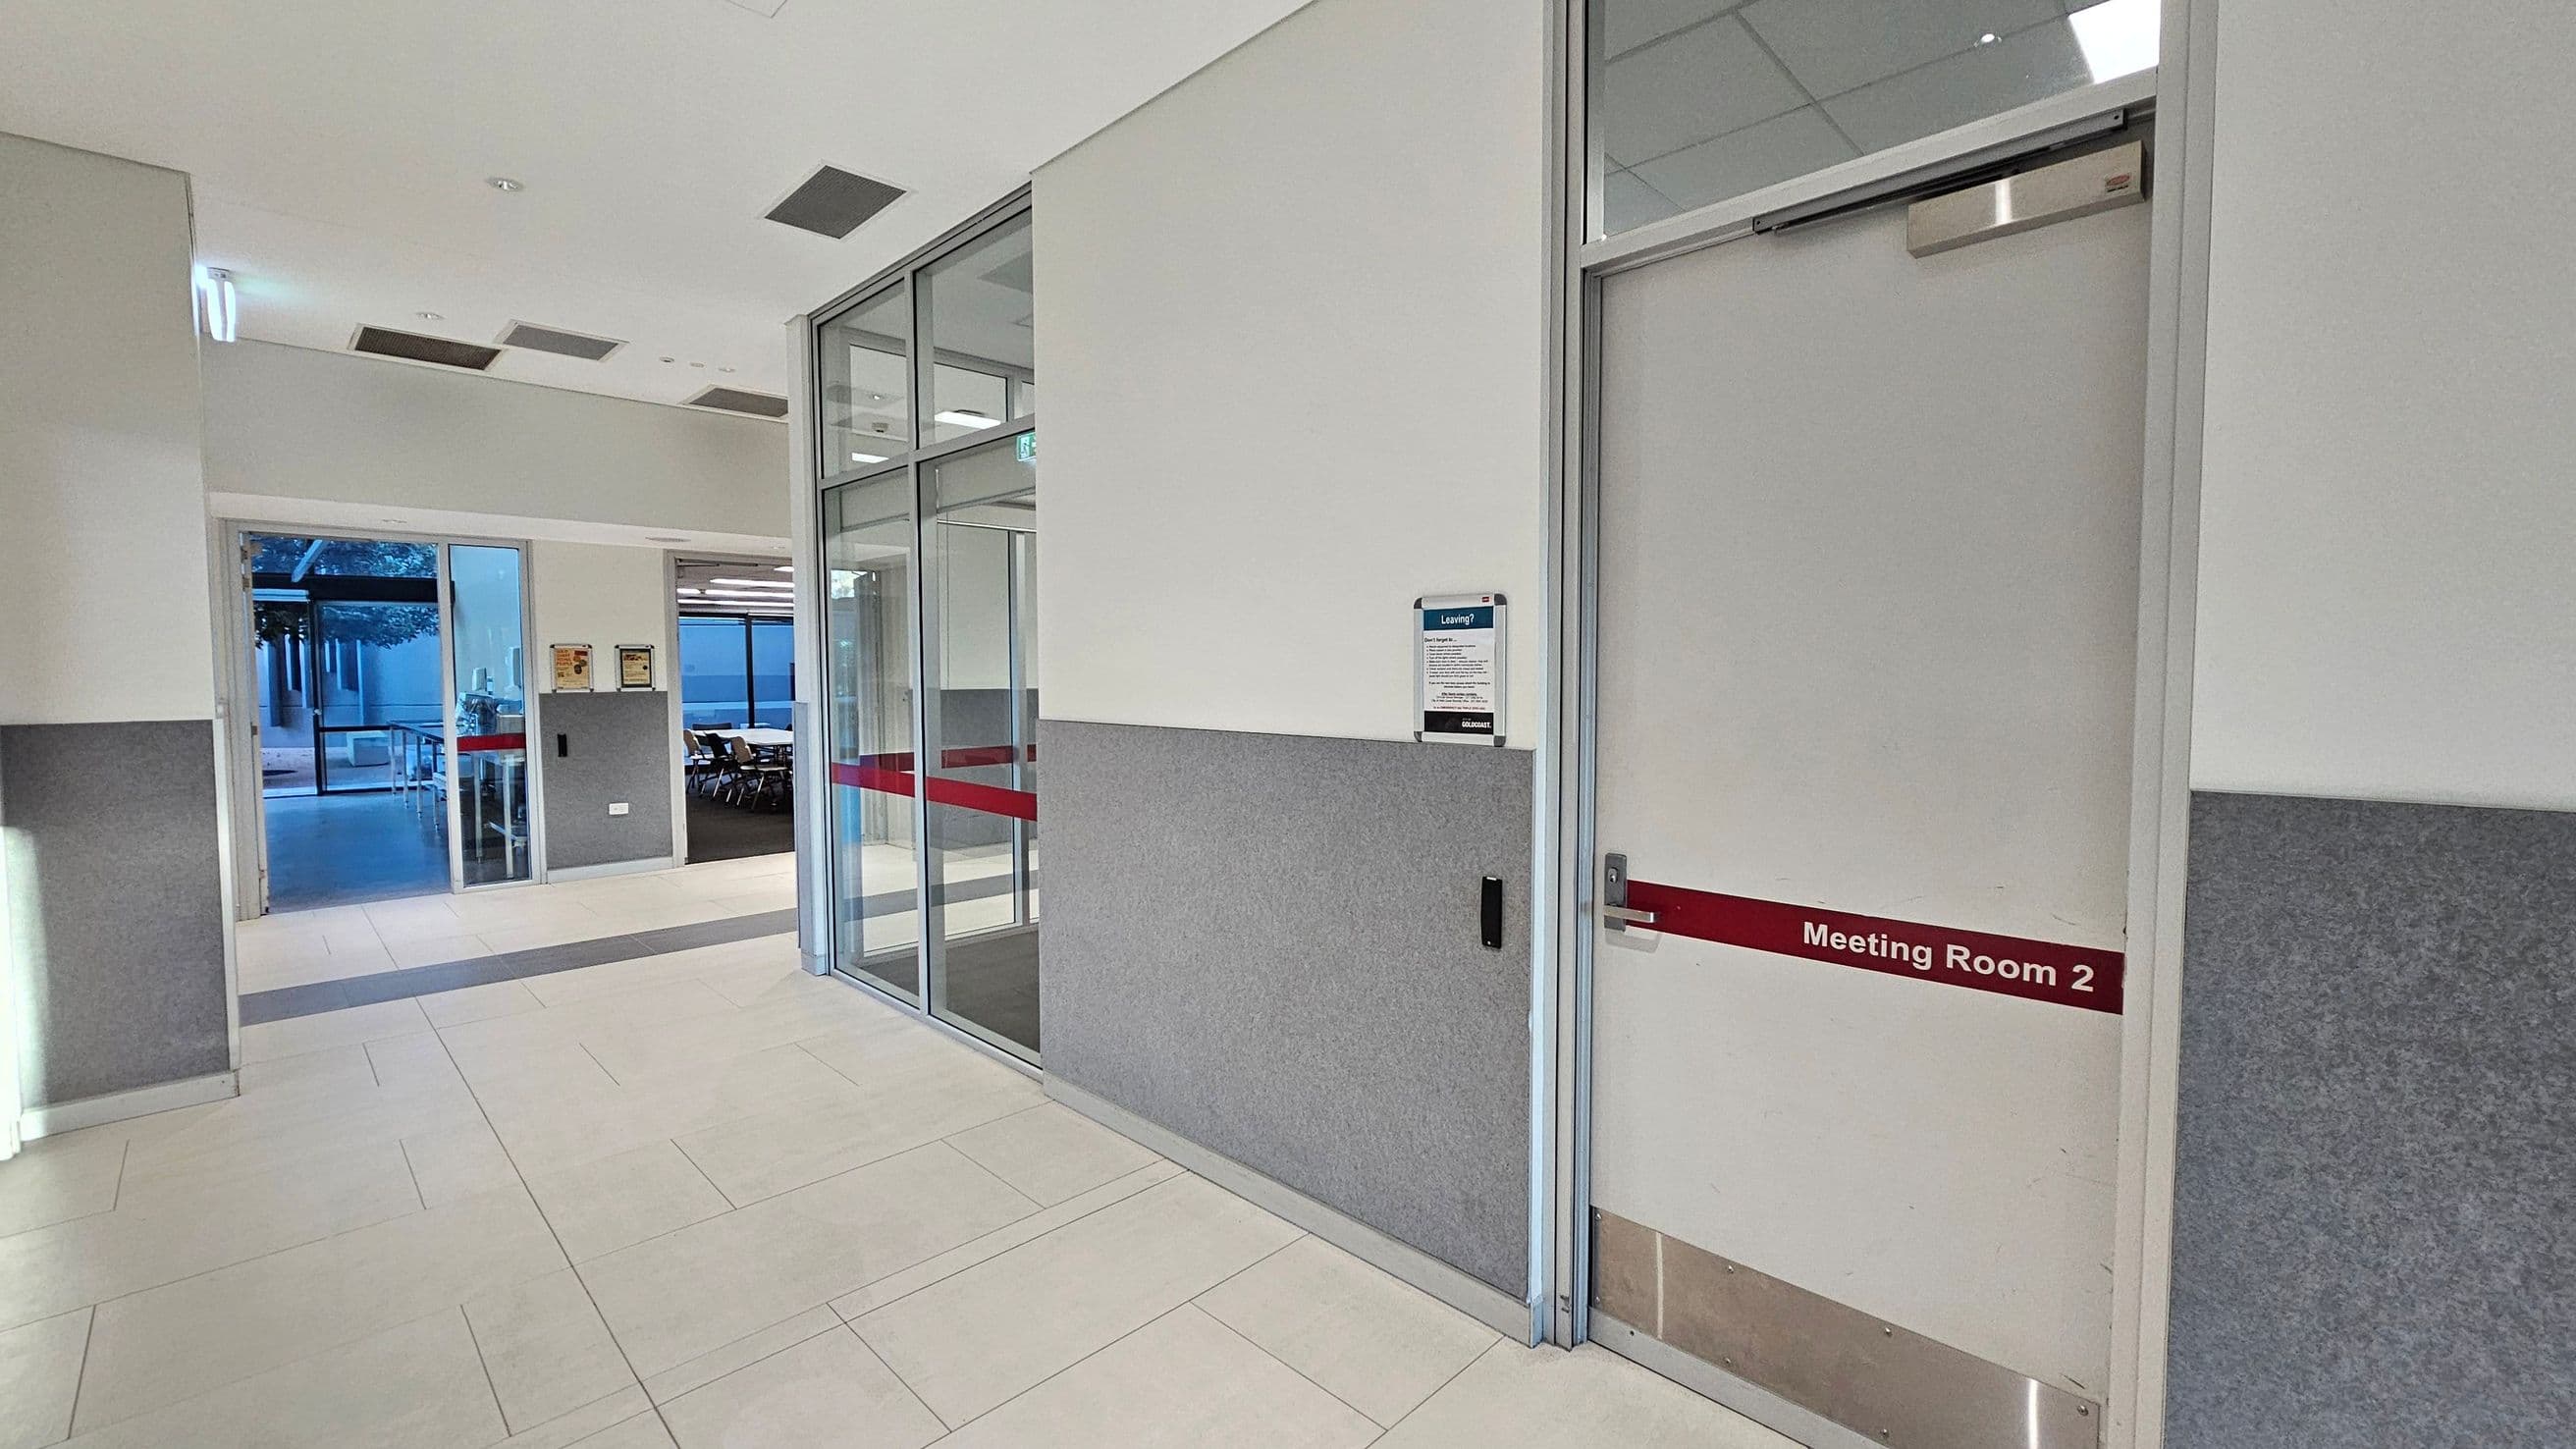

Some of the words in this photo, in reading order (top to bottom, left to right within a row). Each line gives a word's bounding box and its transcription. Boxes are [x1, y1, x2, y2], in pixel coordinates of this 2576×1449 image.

[1441, 613, 1475, 625] Leaving?
[1803, 921, 1932, 971] Meeting
[1946, 943, 2057, 987] Room
[2071, 964, 2095, 993] 2
